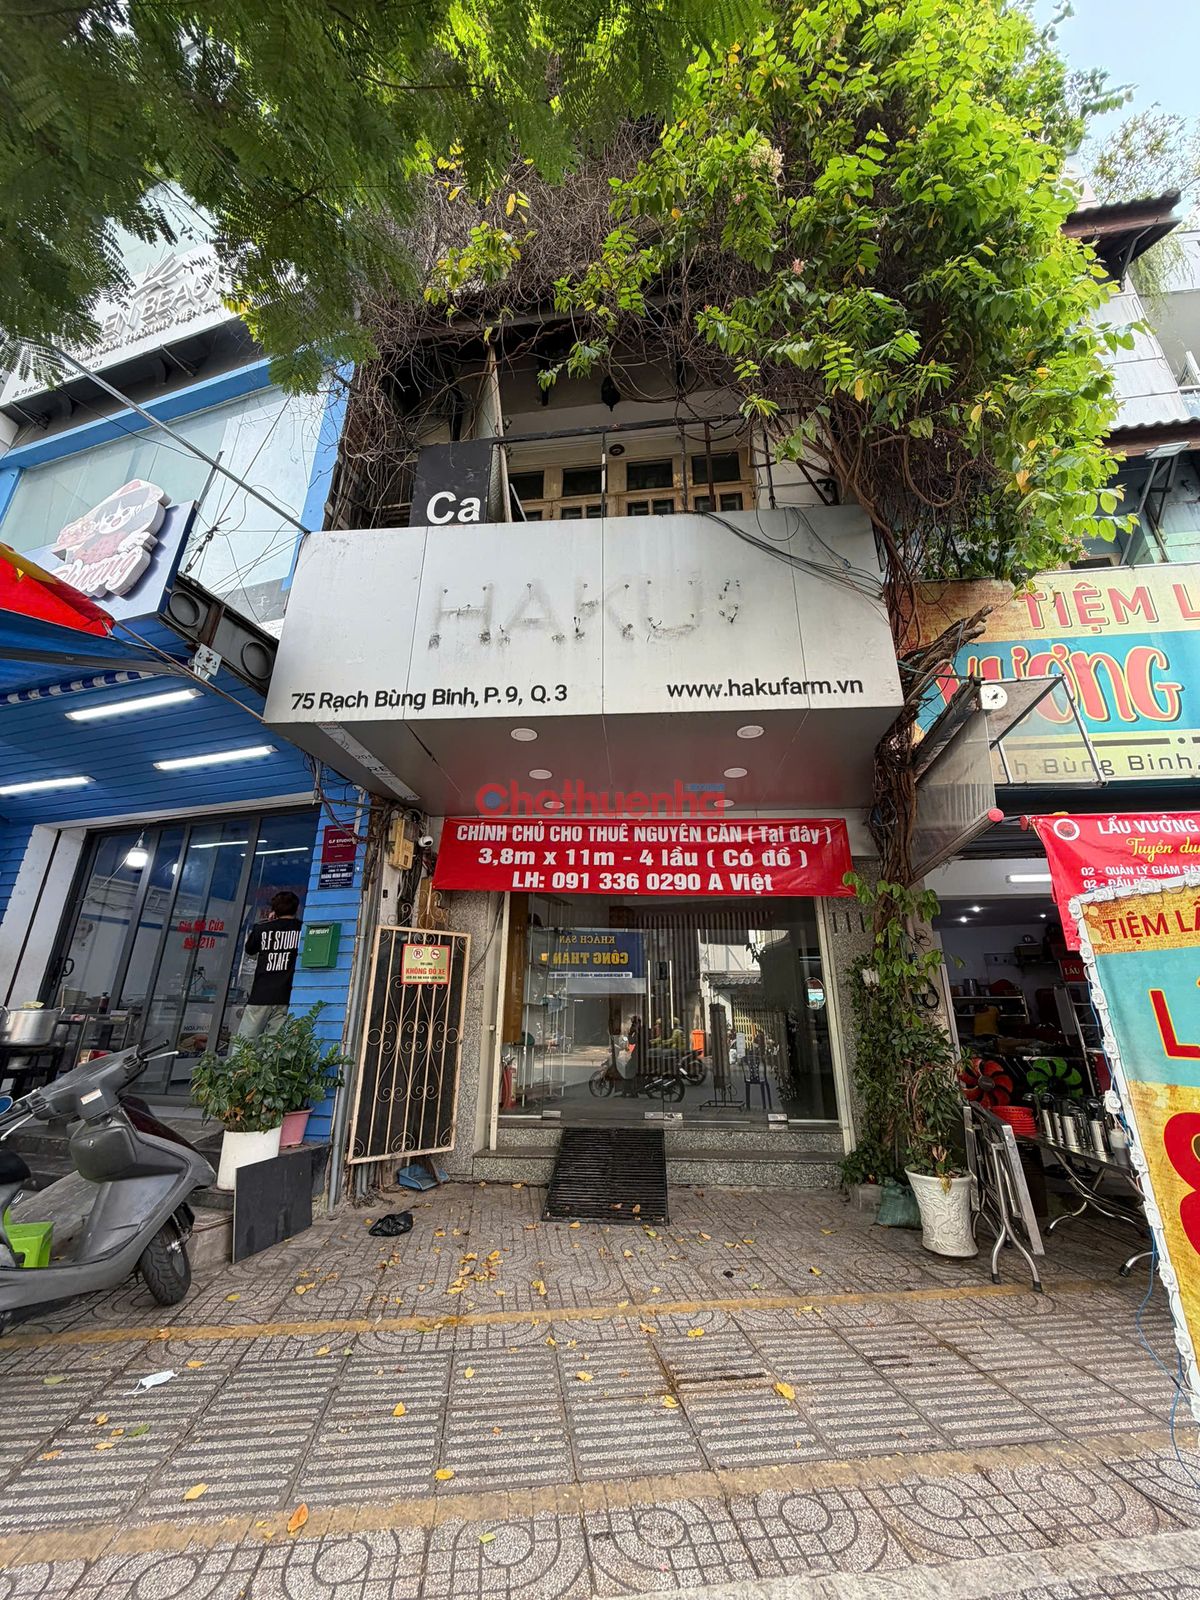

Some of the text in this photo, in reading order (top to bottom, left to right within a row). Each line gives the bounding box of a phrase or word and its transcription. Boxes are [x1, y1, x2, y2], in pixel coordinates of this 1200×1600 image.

[427, 491, 480, 525] Ca
[1017, 581, 1158, 633] TIỆM
[667, 677, 864, 698] www.hakufarm.vn
[291, 693, 315, 710] 75
[318, 690, 368, 712] Rạch
[374, 688, 427, 710] Bùng
[457, 822, 507, 841] CHÍNH
[512, 821, 545, 842] CHỦ
[550, 826, 582, 842] CHO
[588, 823, 628, 842] THUÊ
[634, 823, 700, 842] NGUYÊN
[707, 823, 742, 842] CĂN
[478, 848, 535, 866] 3,8m
[543, 851, 557, 865] x
[566, 849, 614, 866] 11m
[639, 849, 654, 866] 4
[662, 846, 698, 866] lầu
[512, 871, 774, 894] LH: 091 336 0290 A Việt
[1081, 867, 1095, 876] 02
[1103, 911, 1170, 944] TIỆM
[266, 952, 291, 971] STAFF
